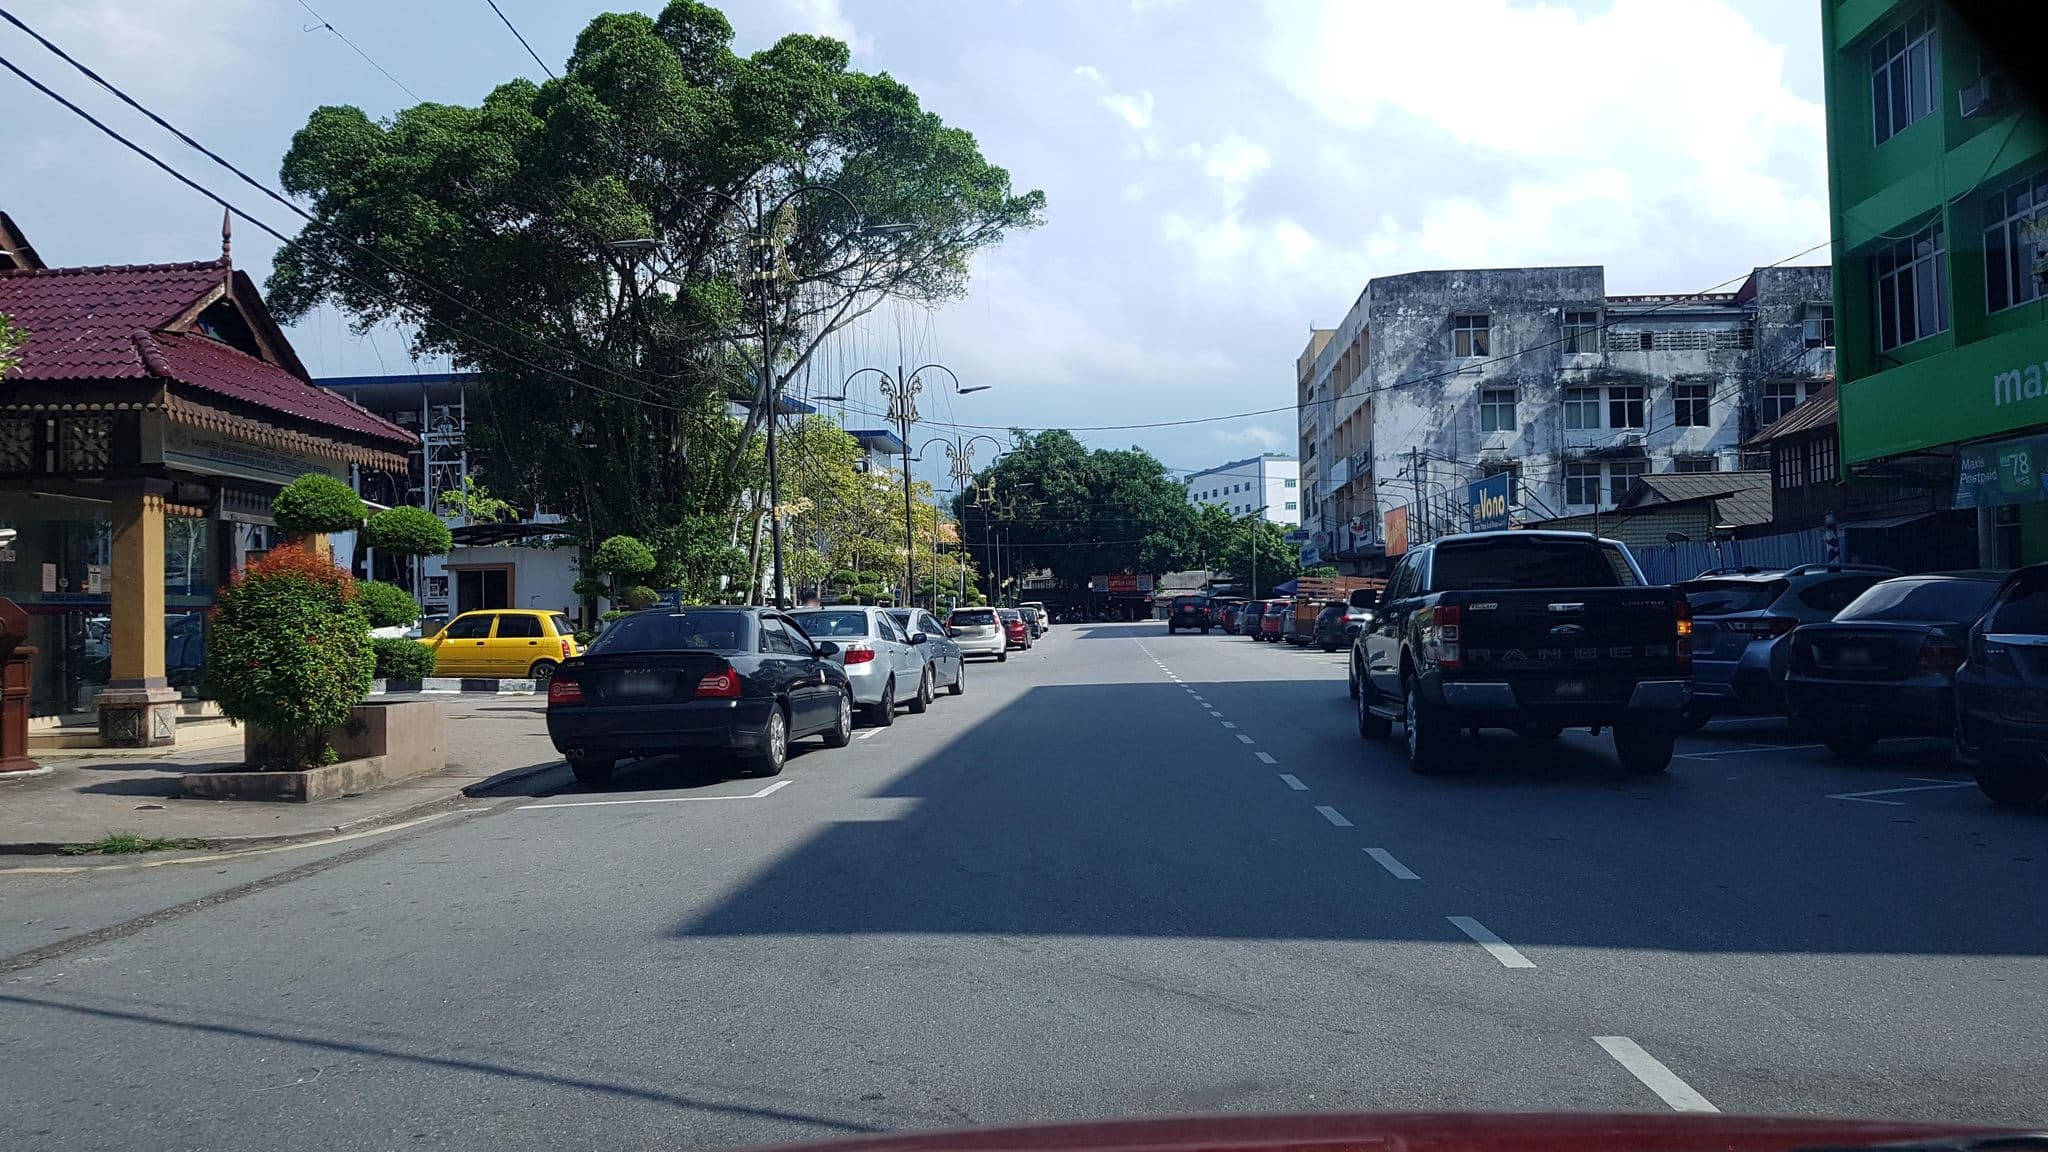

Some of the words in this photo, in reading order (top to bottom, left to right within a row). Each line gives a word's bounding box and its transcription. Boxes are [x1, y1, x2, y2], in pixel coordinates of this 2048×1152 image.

[1961, 456, 1985, 471] Maxis
[2009, 452, 2029, 476] 78
[1960, 468, 1998, 485] Postpaid
[1479, 488, 1504, 519] Vono
[1467, 645, 1669, 661] RANGER
